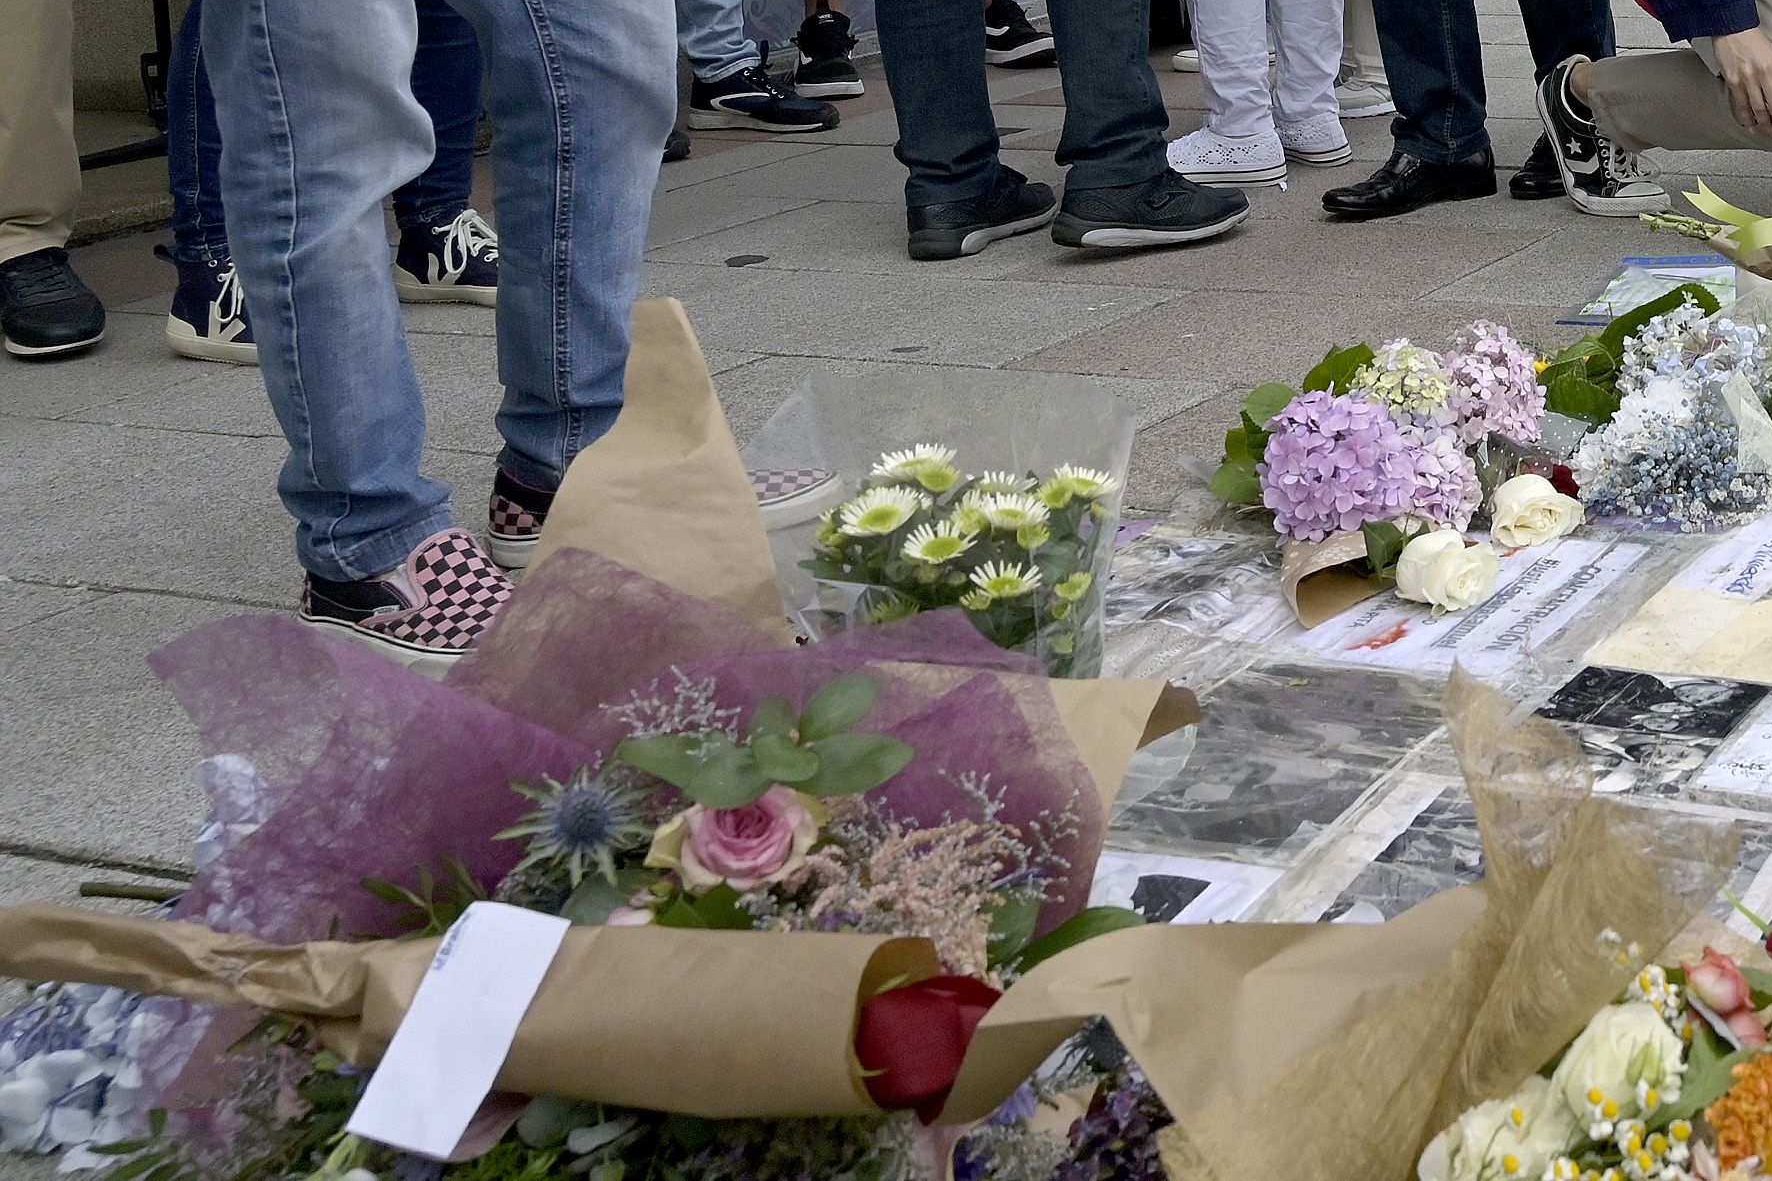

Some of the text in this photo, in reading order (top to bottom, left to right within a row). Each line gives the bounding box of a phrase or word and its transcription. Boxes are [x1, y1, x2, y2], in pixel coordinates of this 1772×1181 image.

[1348, 611, 1380, 627] PITA
[1431, 559, 1558, 648] #justiciaparasamuel
[1486, 565, 1602, 650] CONCENTRACIÓN
